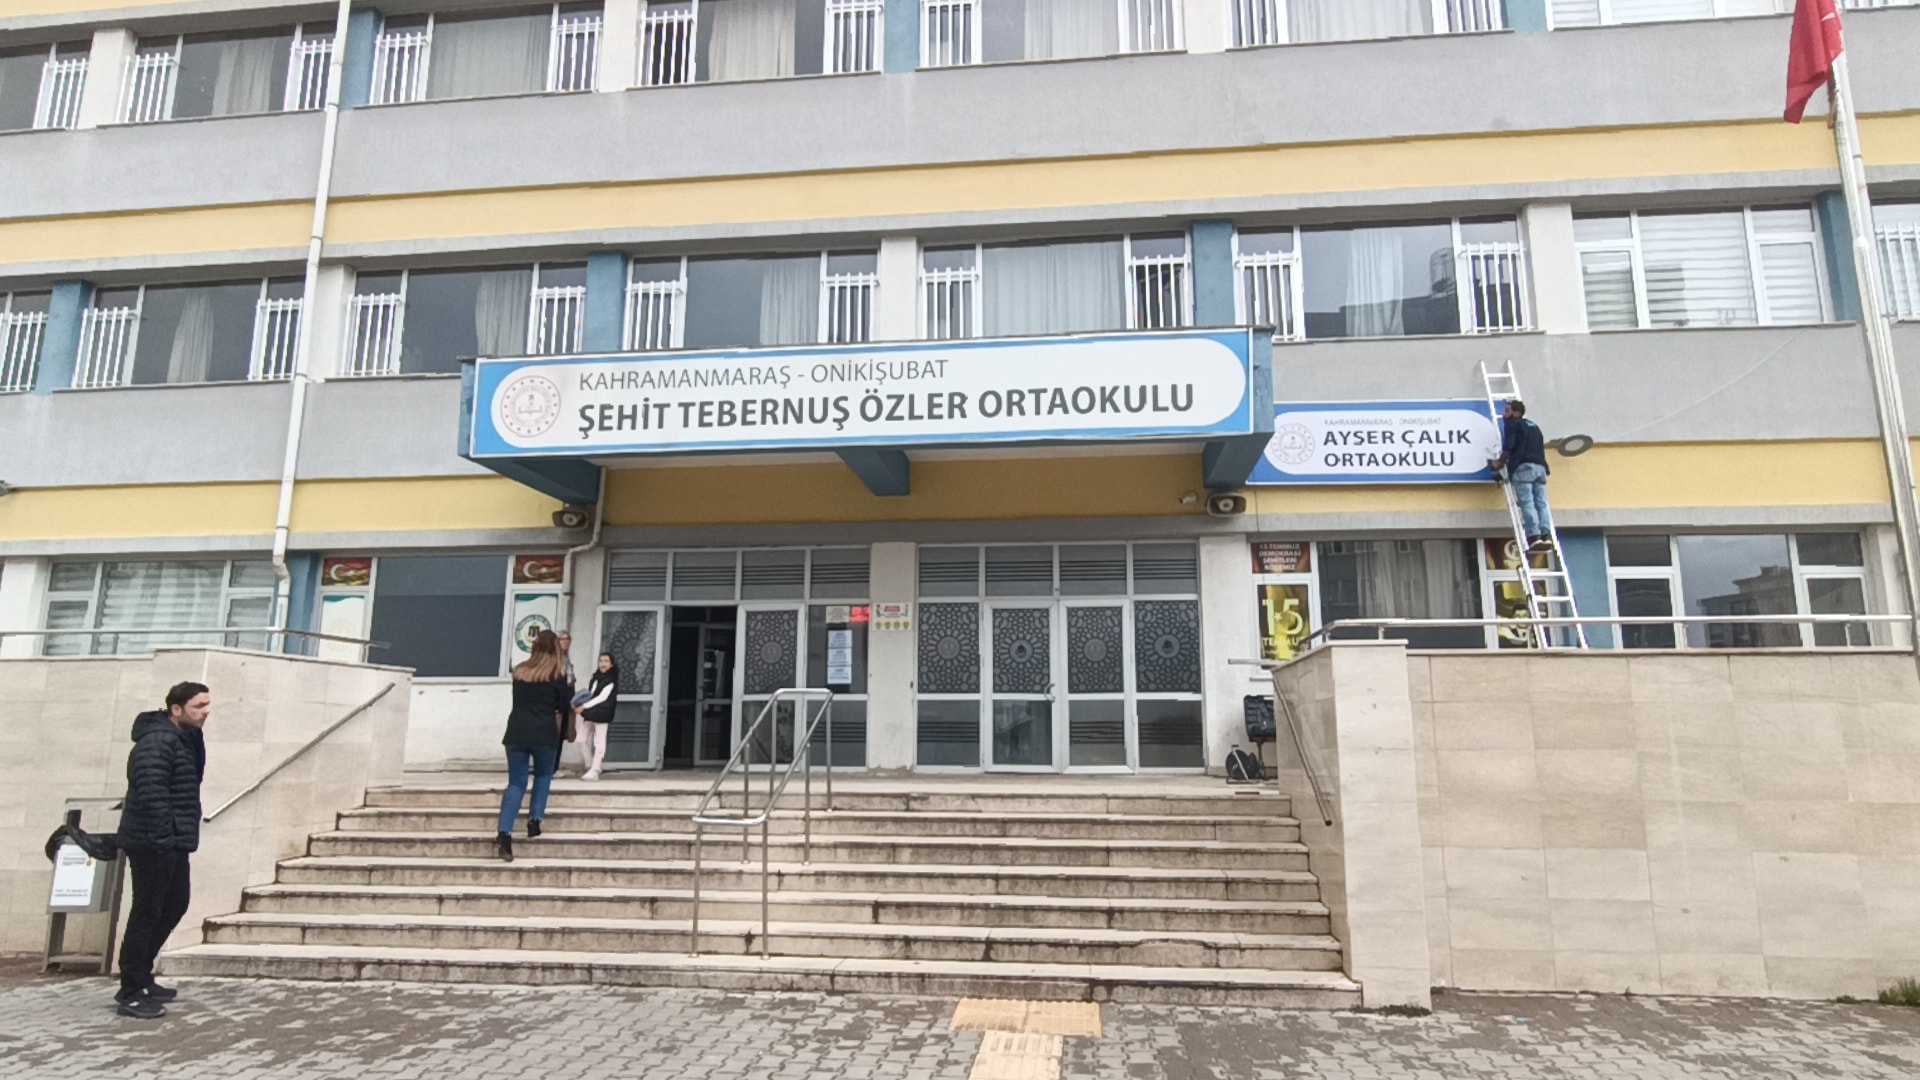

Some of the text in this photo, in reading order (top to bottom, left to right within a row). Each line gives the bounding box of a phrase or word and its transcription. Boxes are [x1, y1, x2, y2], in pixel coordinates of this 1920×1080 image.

[579, 365, 792, 391] KAHRAMANMARAŞ
[811, 359, 949, 385] ONİKİŞUBAT
[579, 398, 671, 439] ŞEHİT
[678, 396, 850, 431] TEBERNUŞ
[859, 388, 968, 423] ÖZLER
[978, 383, 1194, 417] ORTAOKULU
[1401, 429, 1471, 448] ÇALIK
[1324, 451, 1455, 467] ORTAOKULU
[1262, 598, 1303, 635] 15
